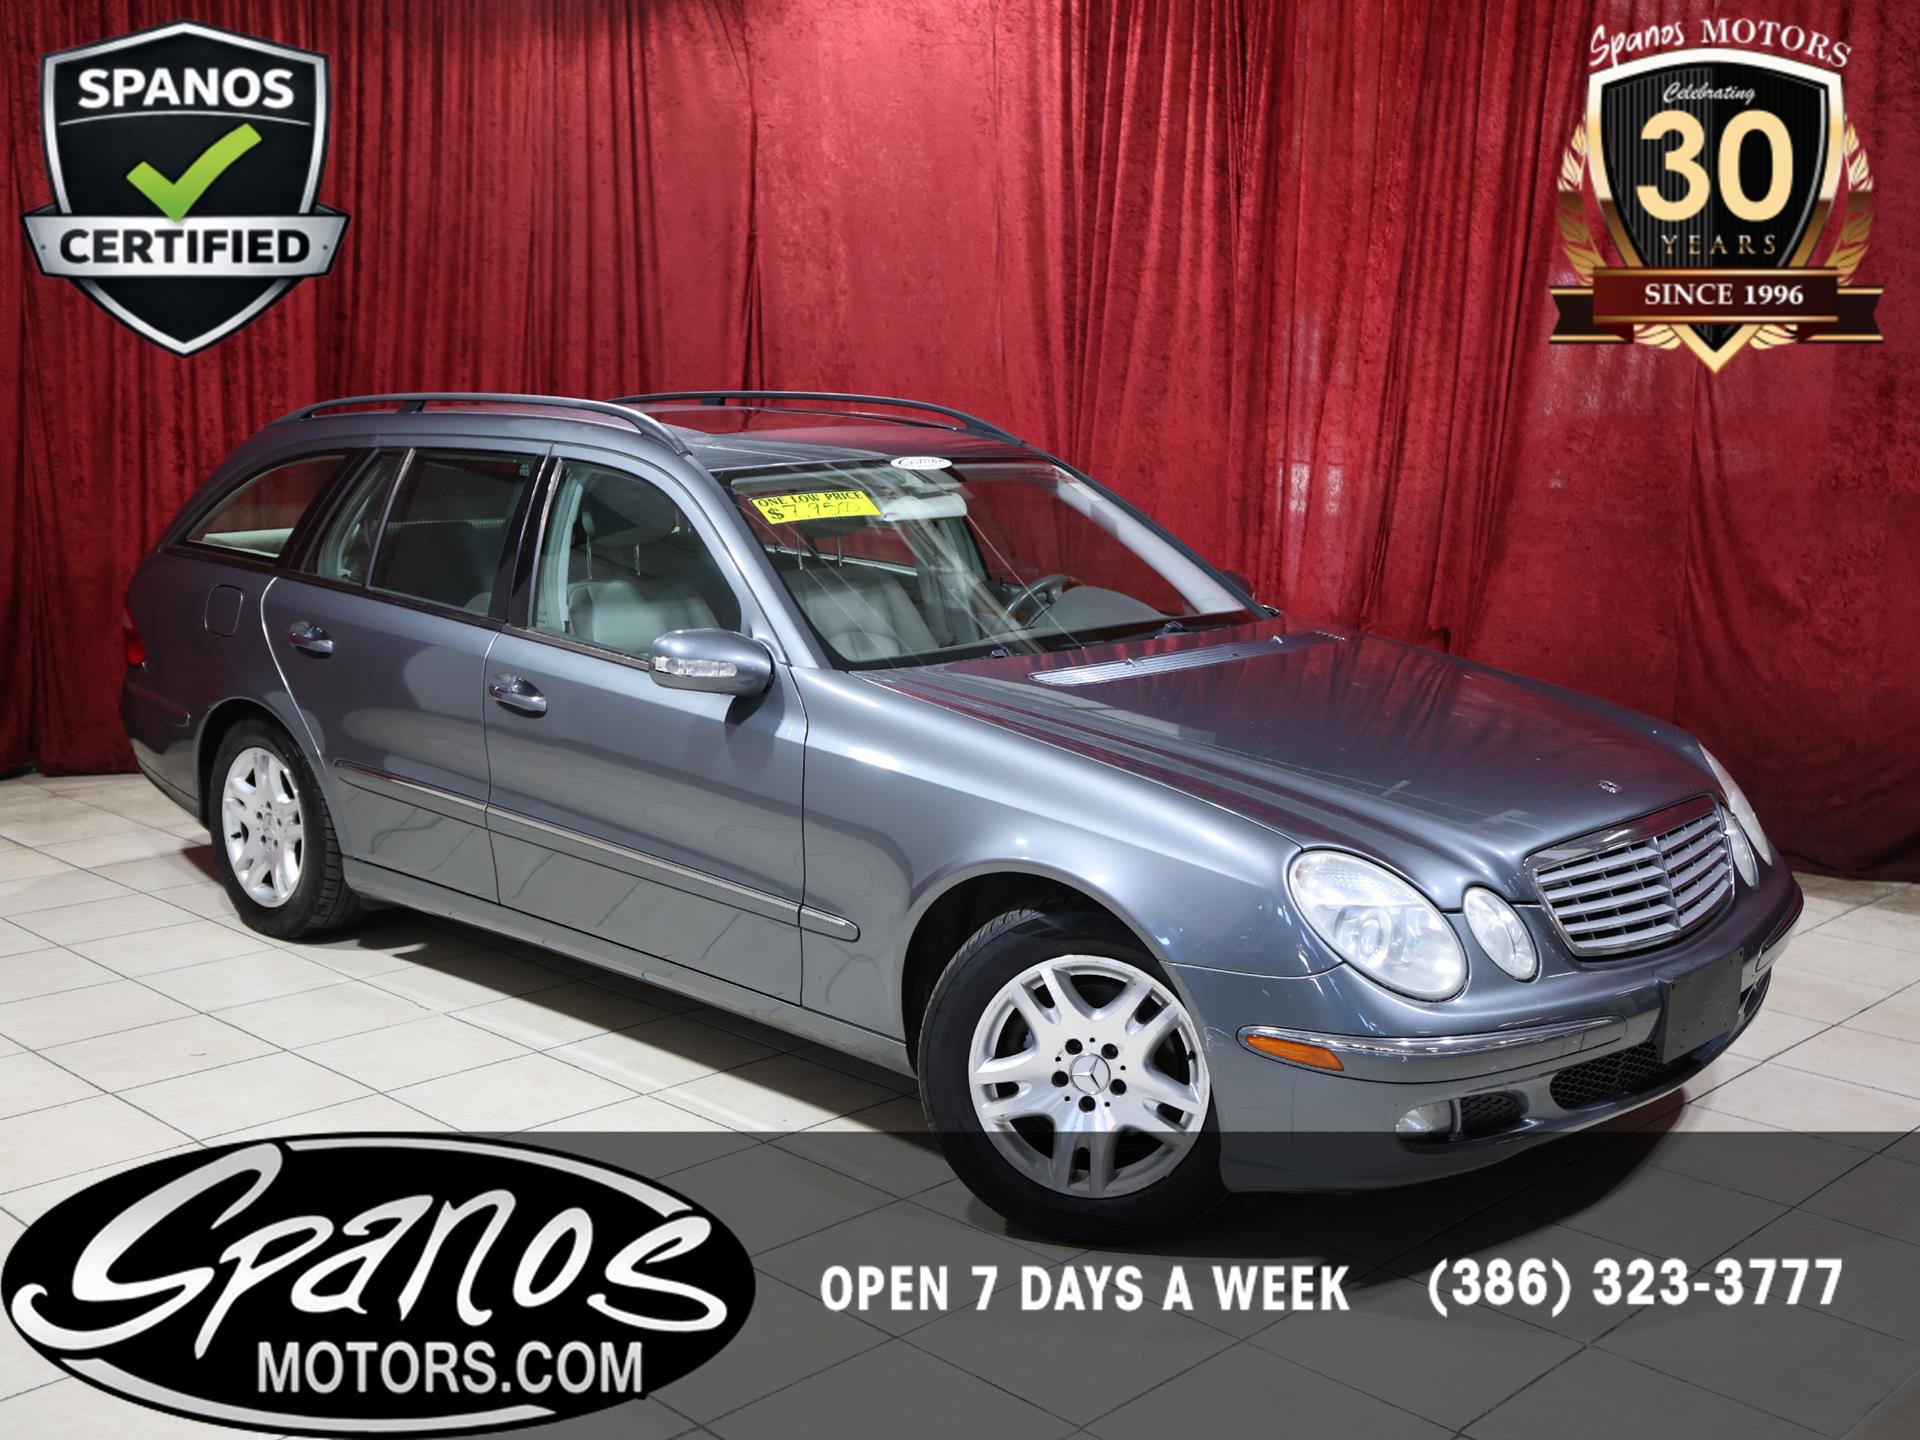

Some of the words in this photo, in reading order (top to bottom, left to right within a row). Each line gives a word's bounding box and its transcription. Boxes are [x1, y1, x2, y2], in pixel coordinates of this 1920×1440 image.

[758, 497, 787, 507] ONE
[791, 494, 820, 503] LOW
[824, 491, 863, 500] PRICE
